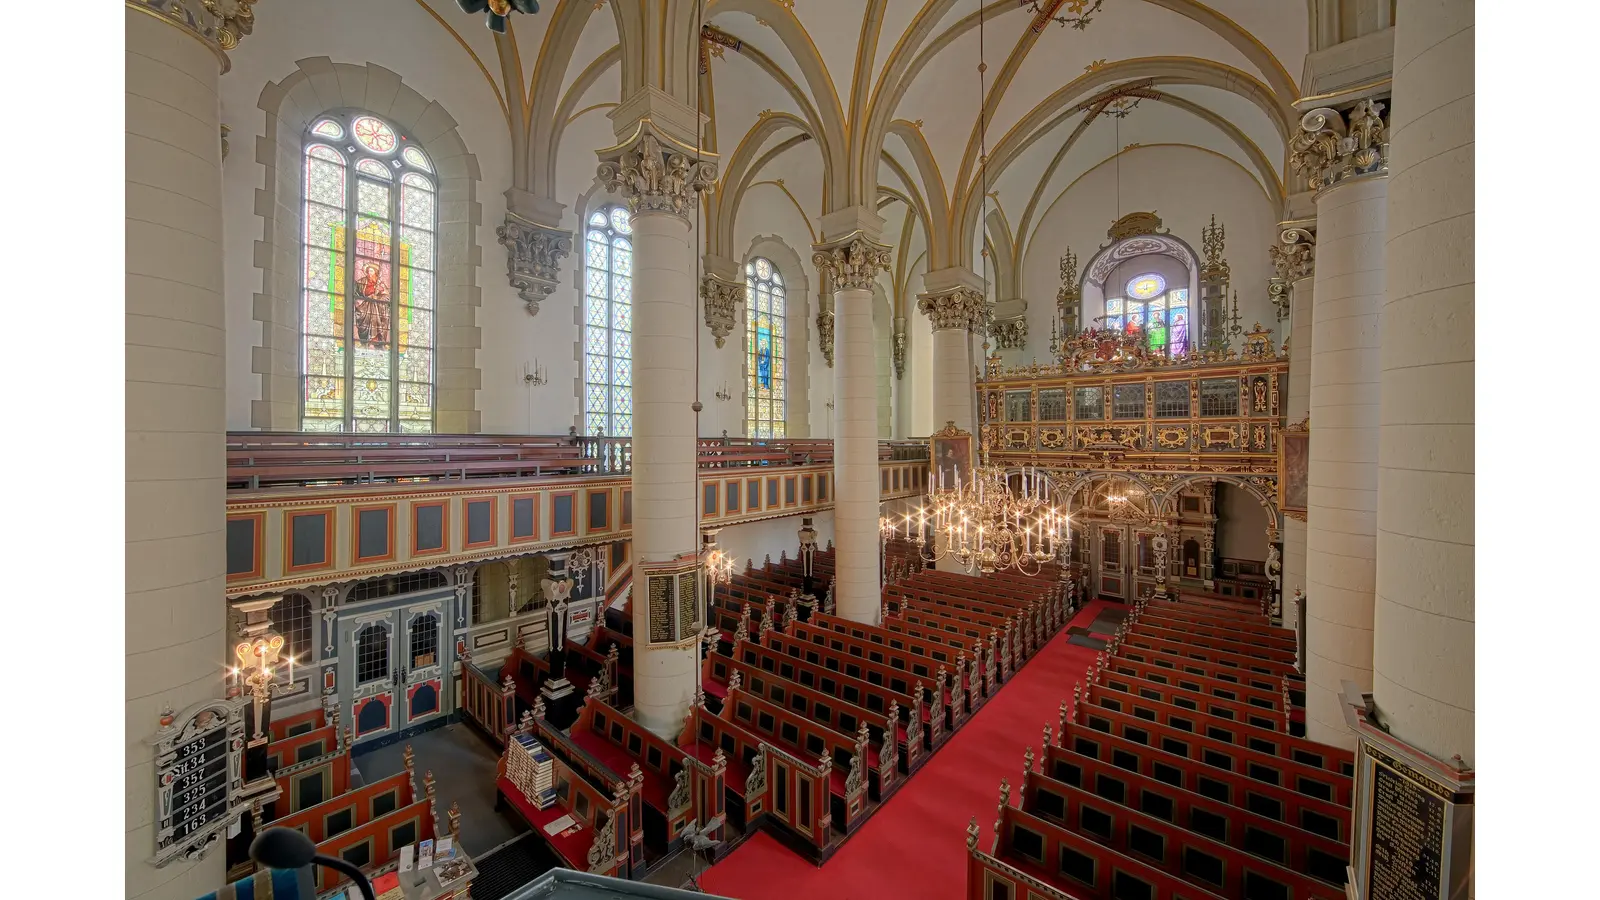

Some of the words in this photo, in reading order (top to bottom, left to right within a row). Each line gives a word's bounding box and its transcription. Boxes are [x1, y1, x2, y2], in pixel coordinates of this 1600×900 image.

[183, 737, 206, 757] 353
[190, 753, 206, 769] 34
[182, 768, 206, 789] 357
[183, 783, 206, 803] 325
[183, 799, 206, 820] 234
[183, 813, 206, 835] 163
